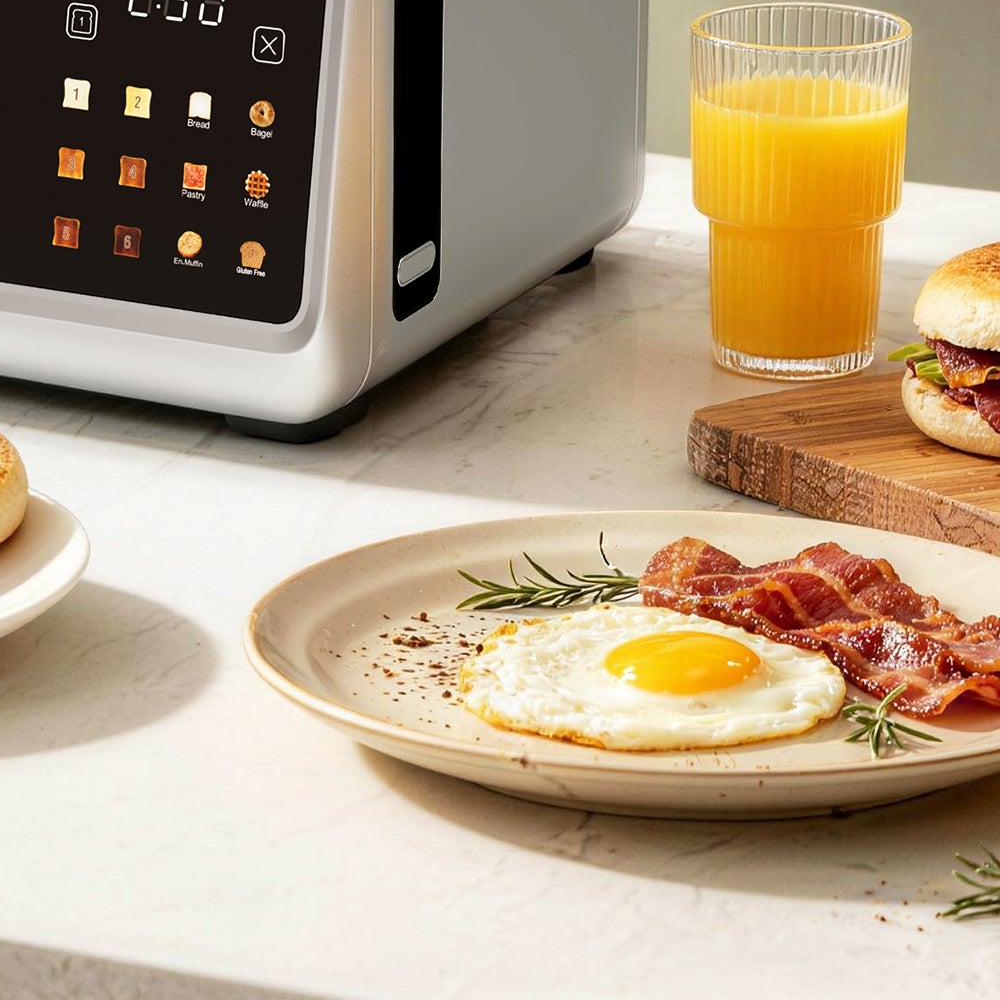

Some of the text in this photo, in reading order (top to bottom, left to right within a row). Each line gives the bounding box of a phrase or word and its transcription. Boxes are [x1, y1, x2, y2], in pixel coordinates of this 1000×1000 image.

[79, 16, 85, 27] 1
[73, 88, 79, 101] 1
[134, 96, 141, 109] 2
[187, 118, 210, 129] Bread
[250, 127, 273, 139] Bagel
[68, 156, 76, 171] 3
[128, 165, 137, 180] 4
[181, 189, 206, 201] Pastry
[244, 198, 269, 209] Waffle
[124, 235, 132, 249] 6
[253, 268, 266, 278] Free
